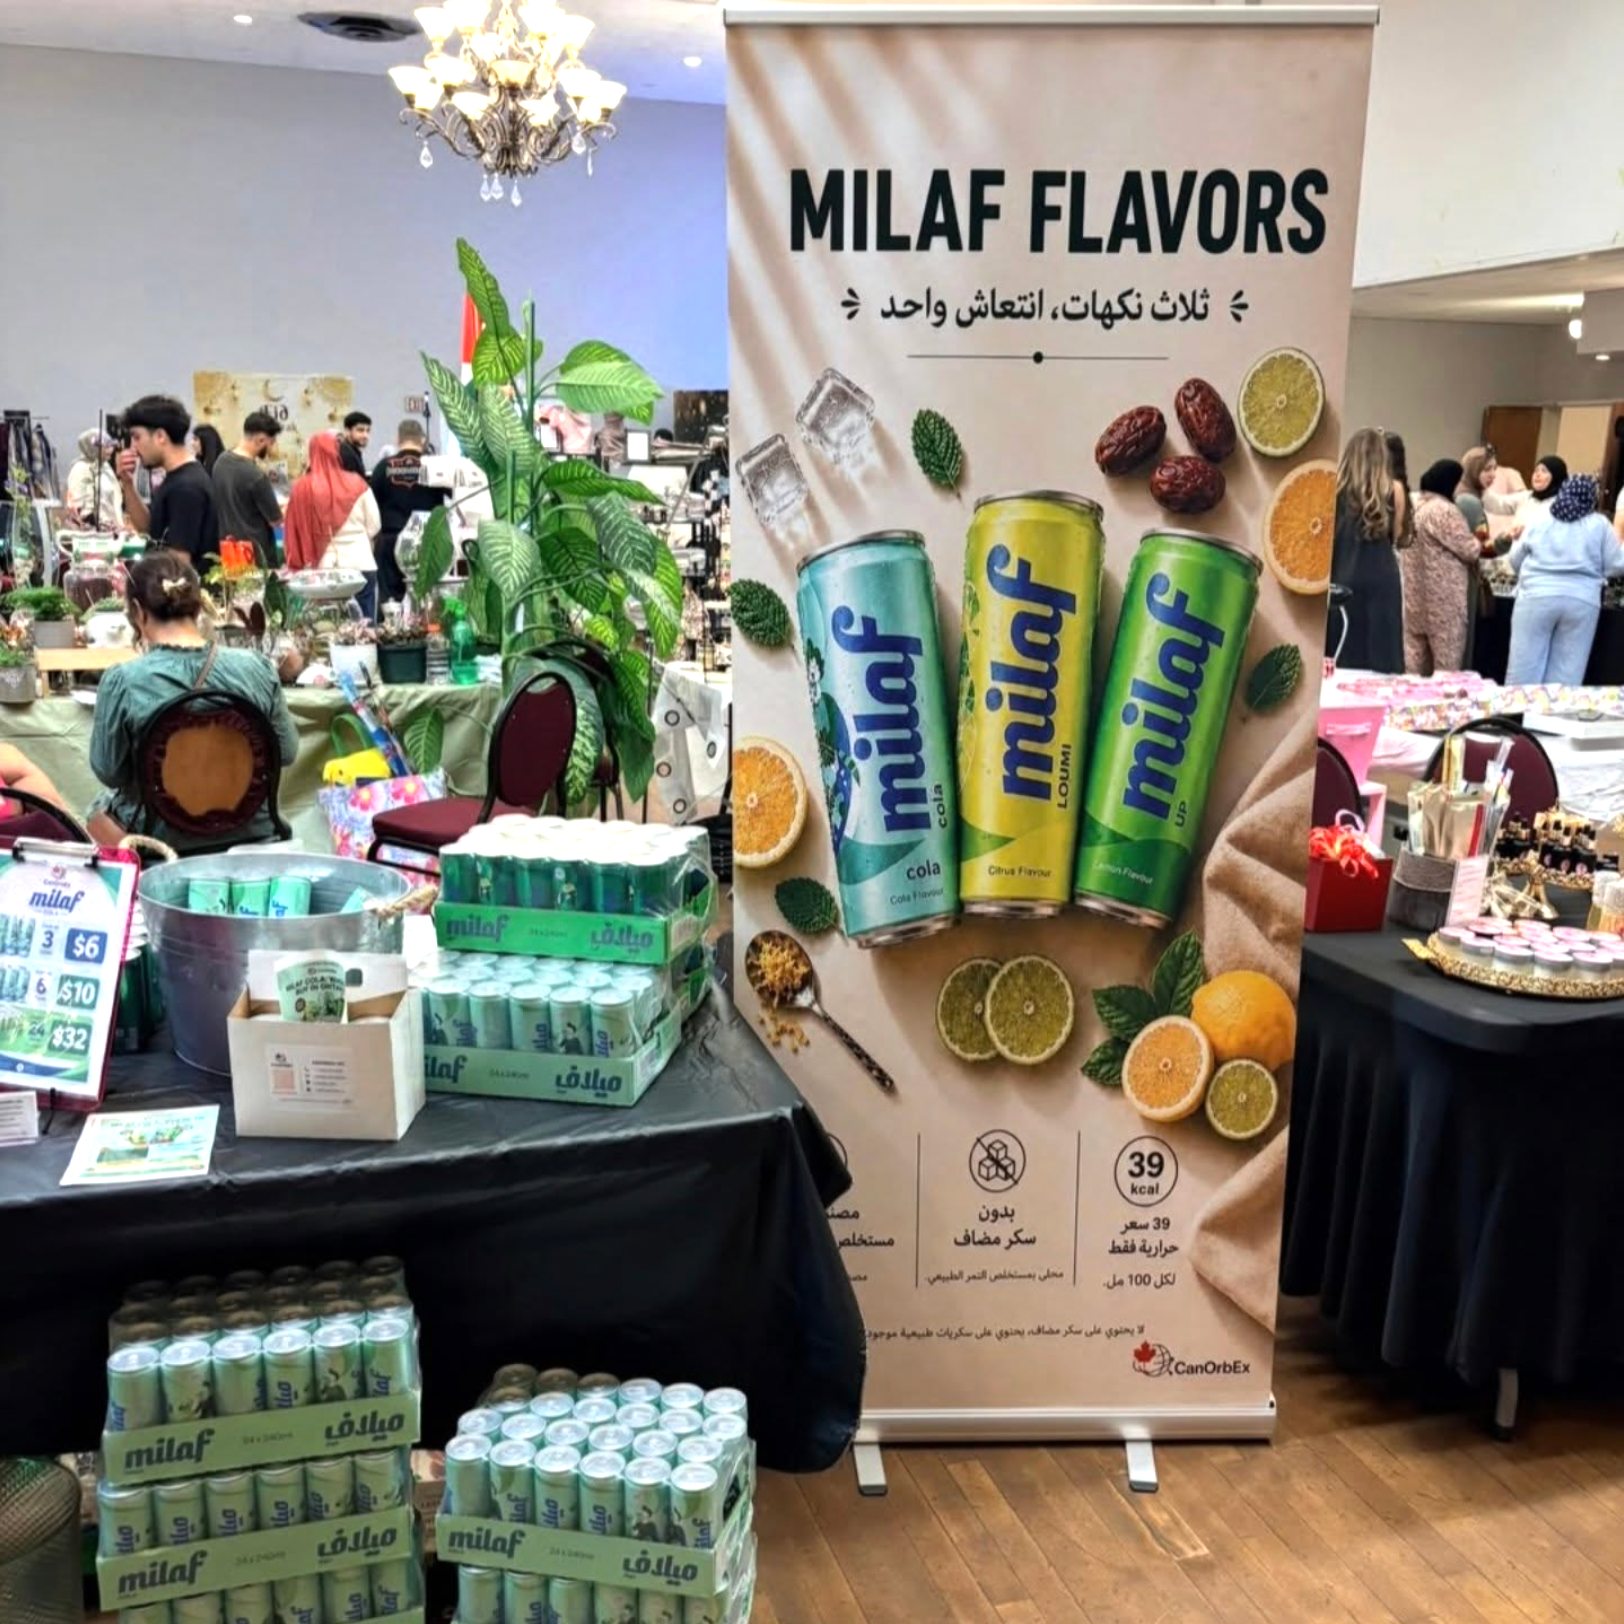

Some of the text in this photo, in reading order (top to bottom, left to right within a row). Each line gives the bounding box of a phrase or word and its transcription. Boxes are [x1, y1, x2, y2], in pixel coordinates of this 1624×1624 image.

[790, 168, 1329, 254] MILAF FLAVORS
[880, 286, 1210, 330] ثلاث نكهات، انتعاش واحد
[986, 543, 1076, 801] milaf
[1123, 572, 1225, 820] milaf
[832, 605, 931, 832] milaf
[1057, 744, 1072, 809] LOUMI
[933, 783, 947, 828] cola
[1175, 800, 1187, 827] UP
[906, 860, 941, 880] cola
[988, 865, 1015, 876] Citrus
[28, 889, 85, 913] milaf
[446, 914, 510, 942] milaf
[41, 930, 100, 958] 3 $6
[36, 977, 96, 1004] 6 $10
[52, 1025, 87, 1050] $32
[556, 1065, 622, 1097] ميلاف
[1128, 1151, 1164, 1178] 39
[1130, 1183, 1159, 1195] kcal
[978, 1205, 1015, 1223] بدون
[1120, 1217, 1170, 1235] 39 سعر
[954, 1228, 1036, 1250] سكر مضاف
[1108, 1240, 1179, 1258] حرارية فقط
[1128, 1274, 1151, 1286] 100
[1154, 1273, 1176, 1289] لكل
[1174, 1360, 1250, 1376] CanOrbEx
[324, 1410, 404, 1443] ميلاف
[125, 1428, 214, 1469] milaf
[317, 1526, 397, 1558] ميلاف
[448, 1527, 526, 1558] milaf
[118, 1551, 207, 1594] milaf
[623, 1550, 698, 1586] ميلاف
